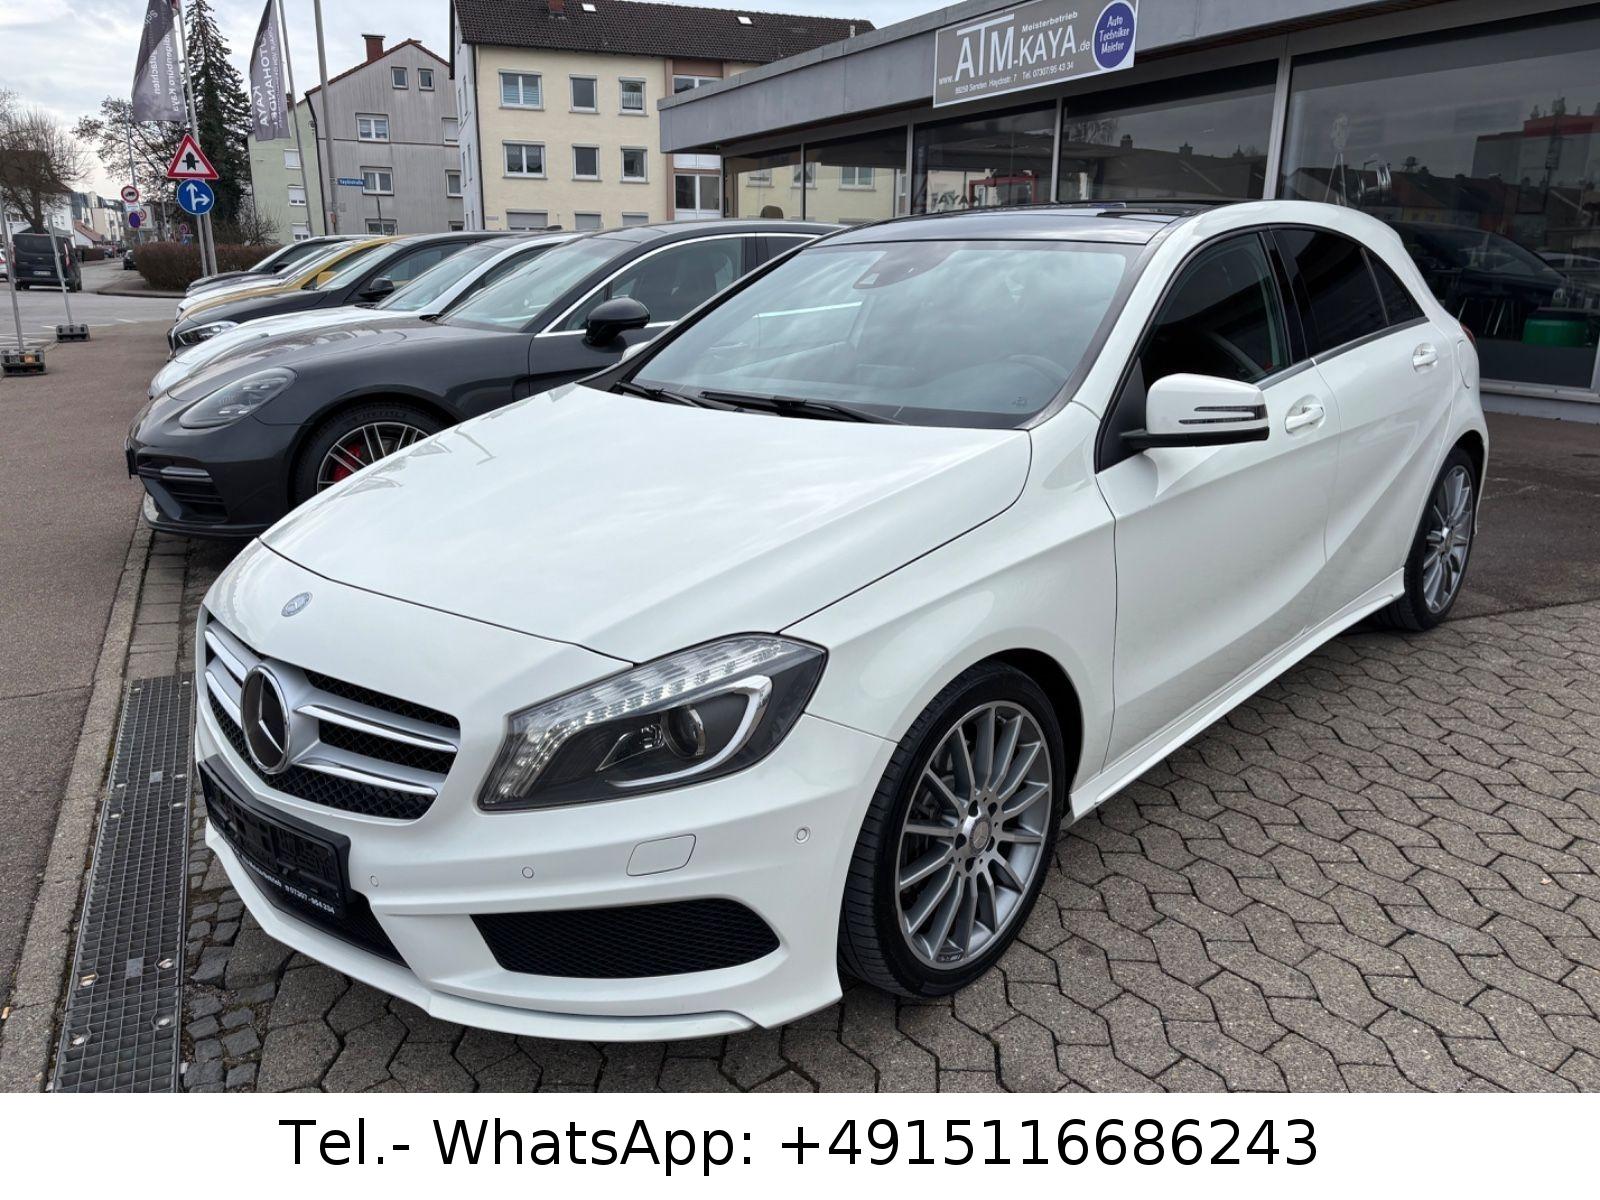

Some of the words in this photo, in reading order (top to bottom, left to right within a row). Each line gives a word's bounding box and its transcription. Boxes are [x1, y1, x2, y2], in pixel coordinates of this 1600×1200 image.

[1022, 10, 1078, 33] Meisterbetrieb
[1107, 15, 1124, 28] Auto
[1099, 27, 1130, 42] Techniker
[1101, 42, 1125, 55] Meister
